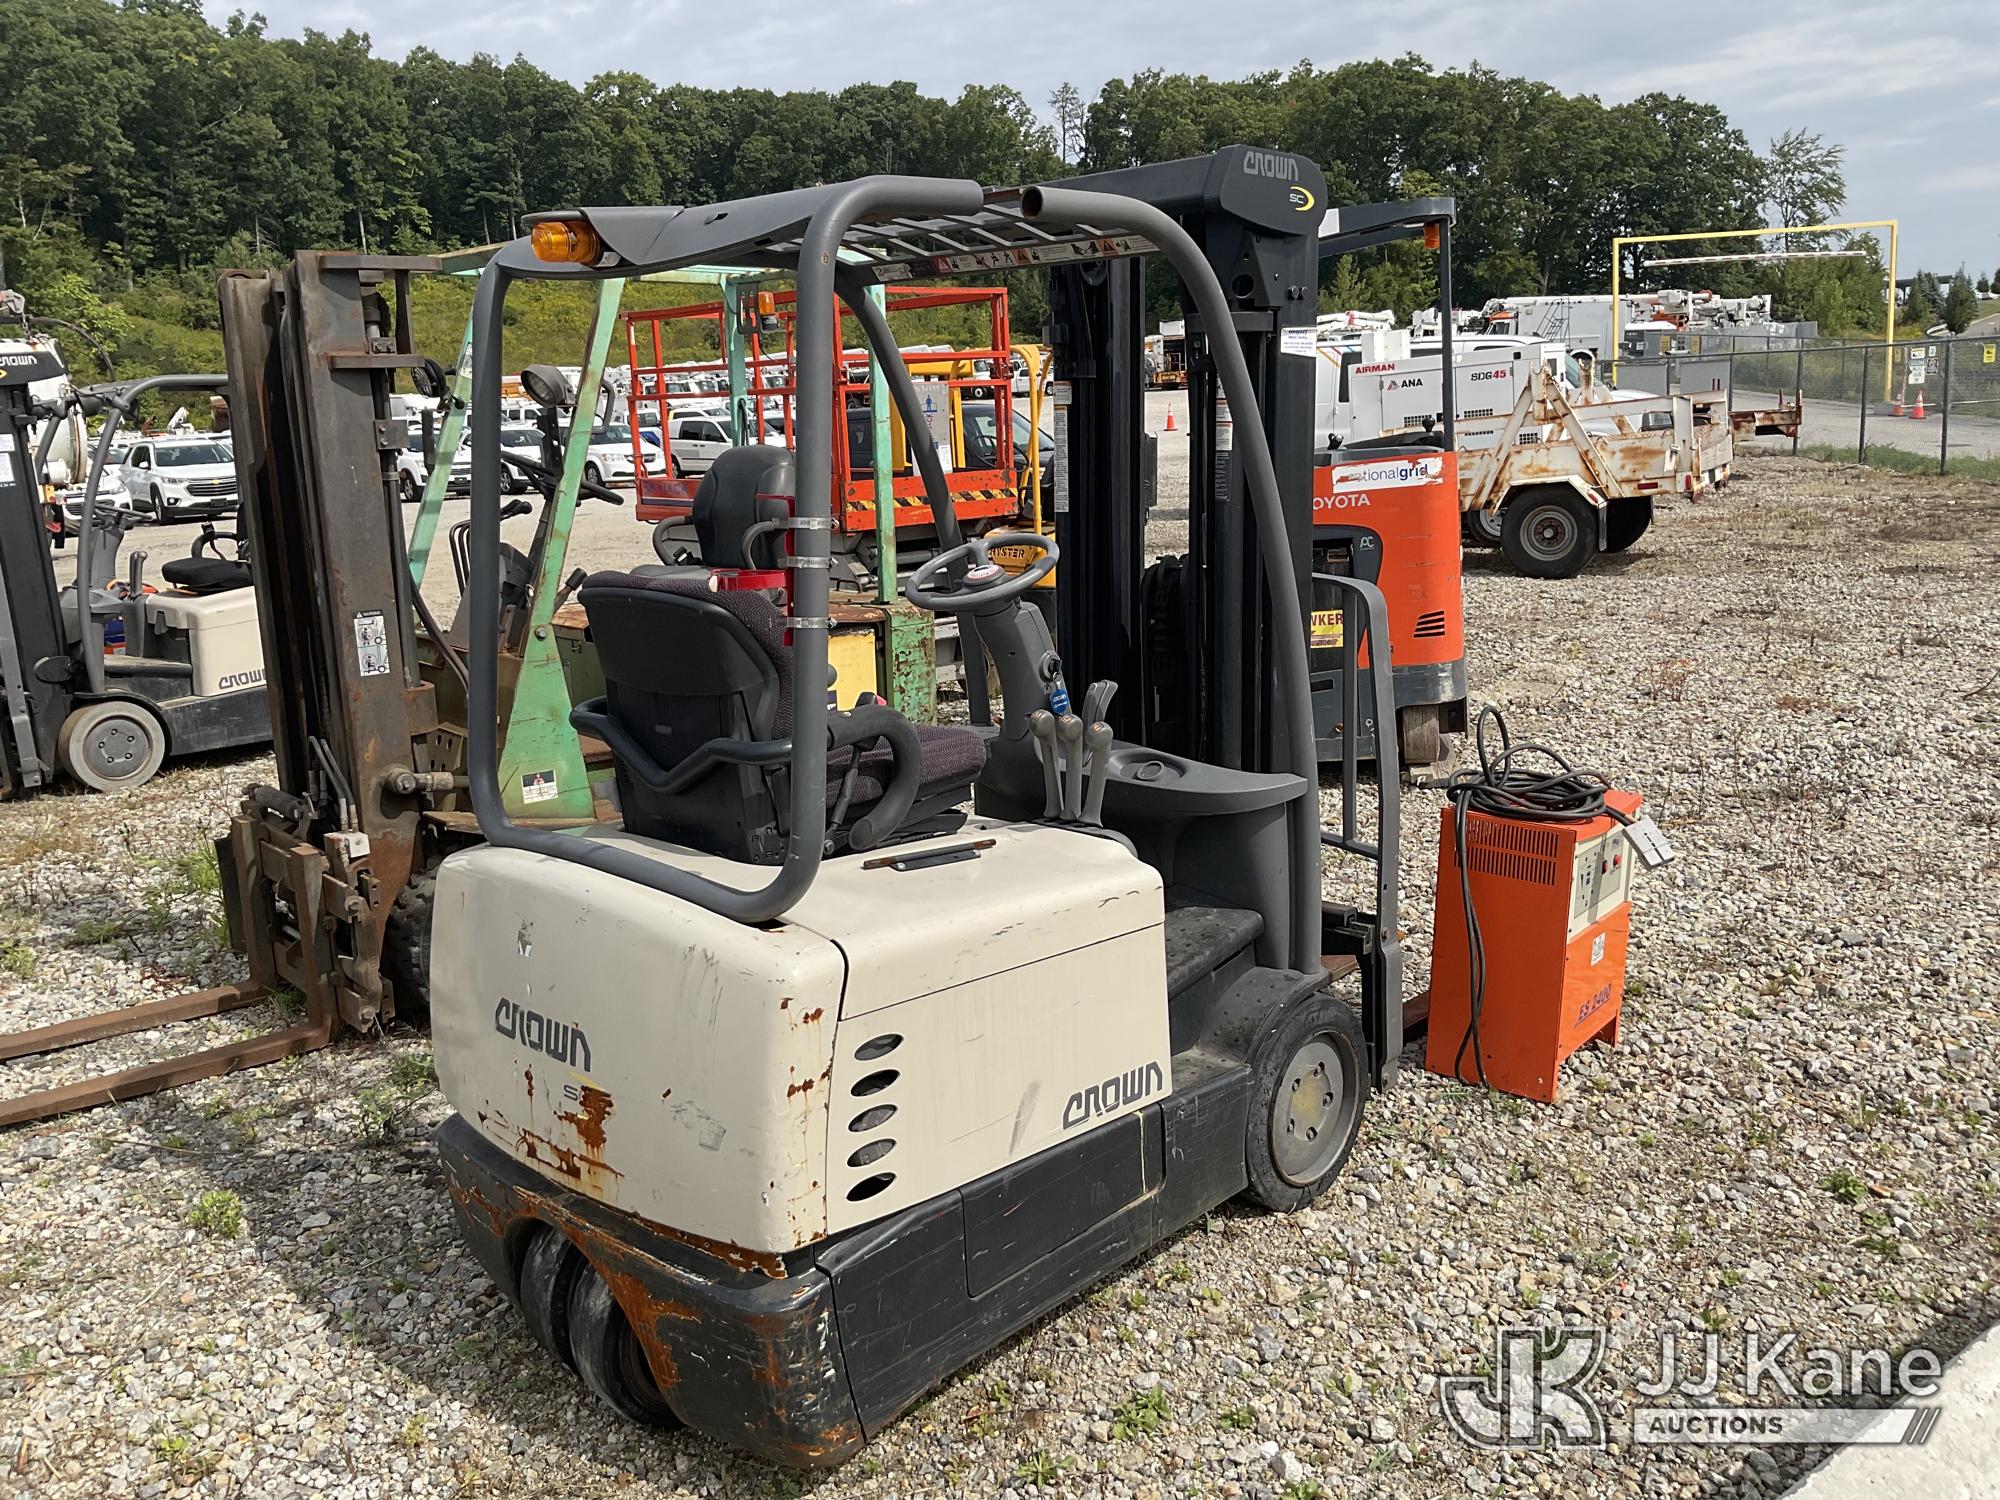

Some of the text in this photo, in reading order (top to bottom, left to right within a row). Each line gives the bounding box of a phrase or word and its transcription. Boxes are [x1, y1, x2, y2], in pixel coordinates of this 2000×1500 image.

[1243, 150, 1299, 181] CROWN
[1289, 193, 1305, 204] SC
[0, 355, 38, 366] ROWN
[1355, 363, 1396, 374] AIRMAN
[1470, 369, 1507, 381] SDG45
[1401, 378, 1423, 388] ANA
[1313, 493, 1371, 510] OYOTA
[1591, 983, 1612, 1010] 2400
[495, 997, 592, 1073] CROWN
[1062, 1061, 1163, 1130] CROWN
